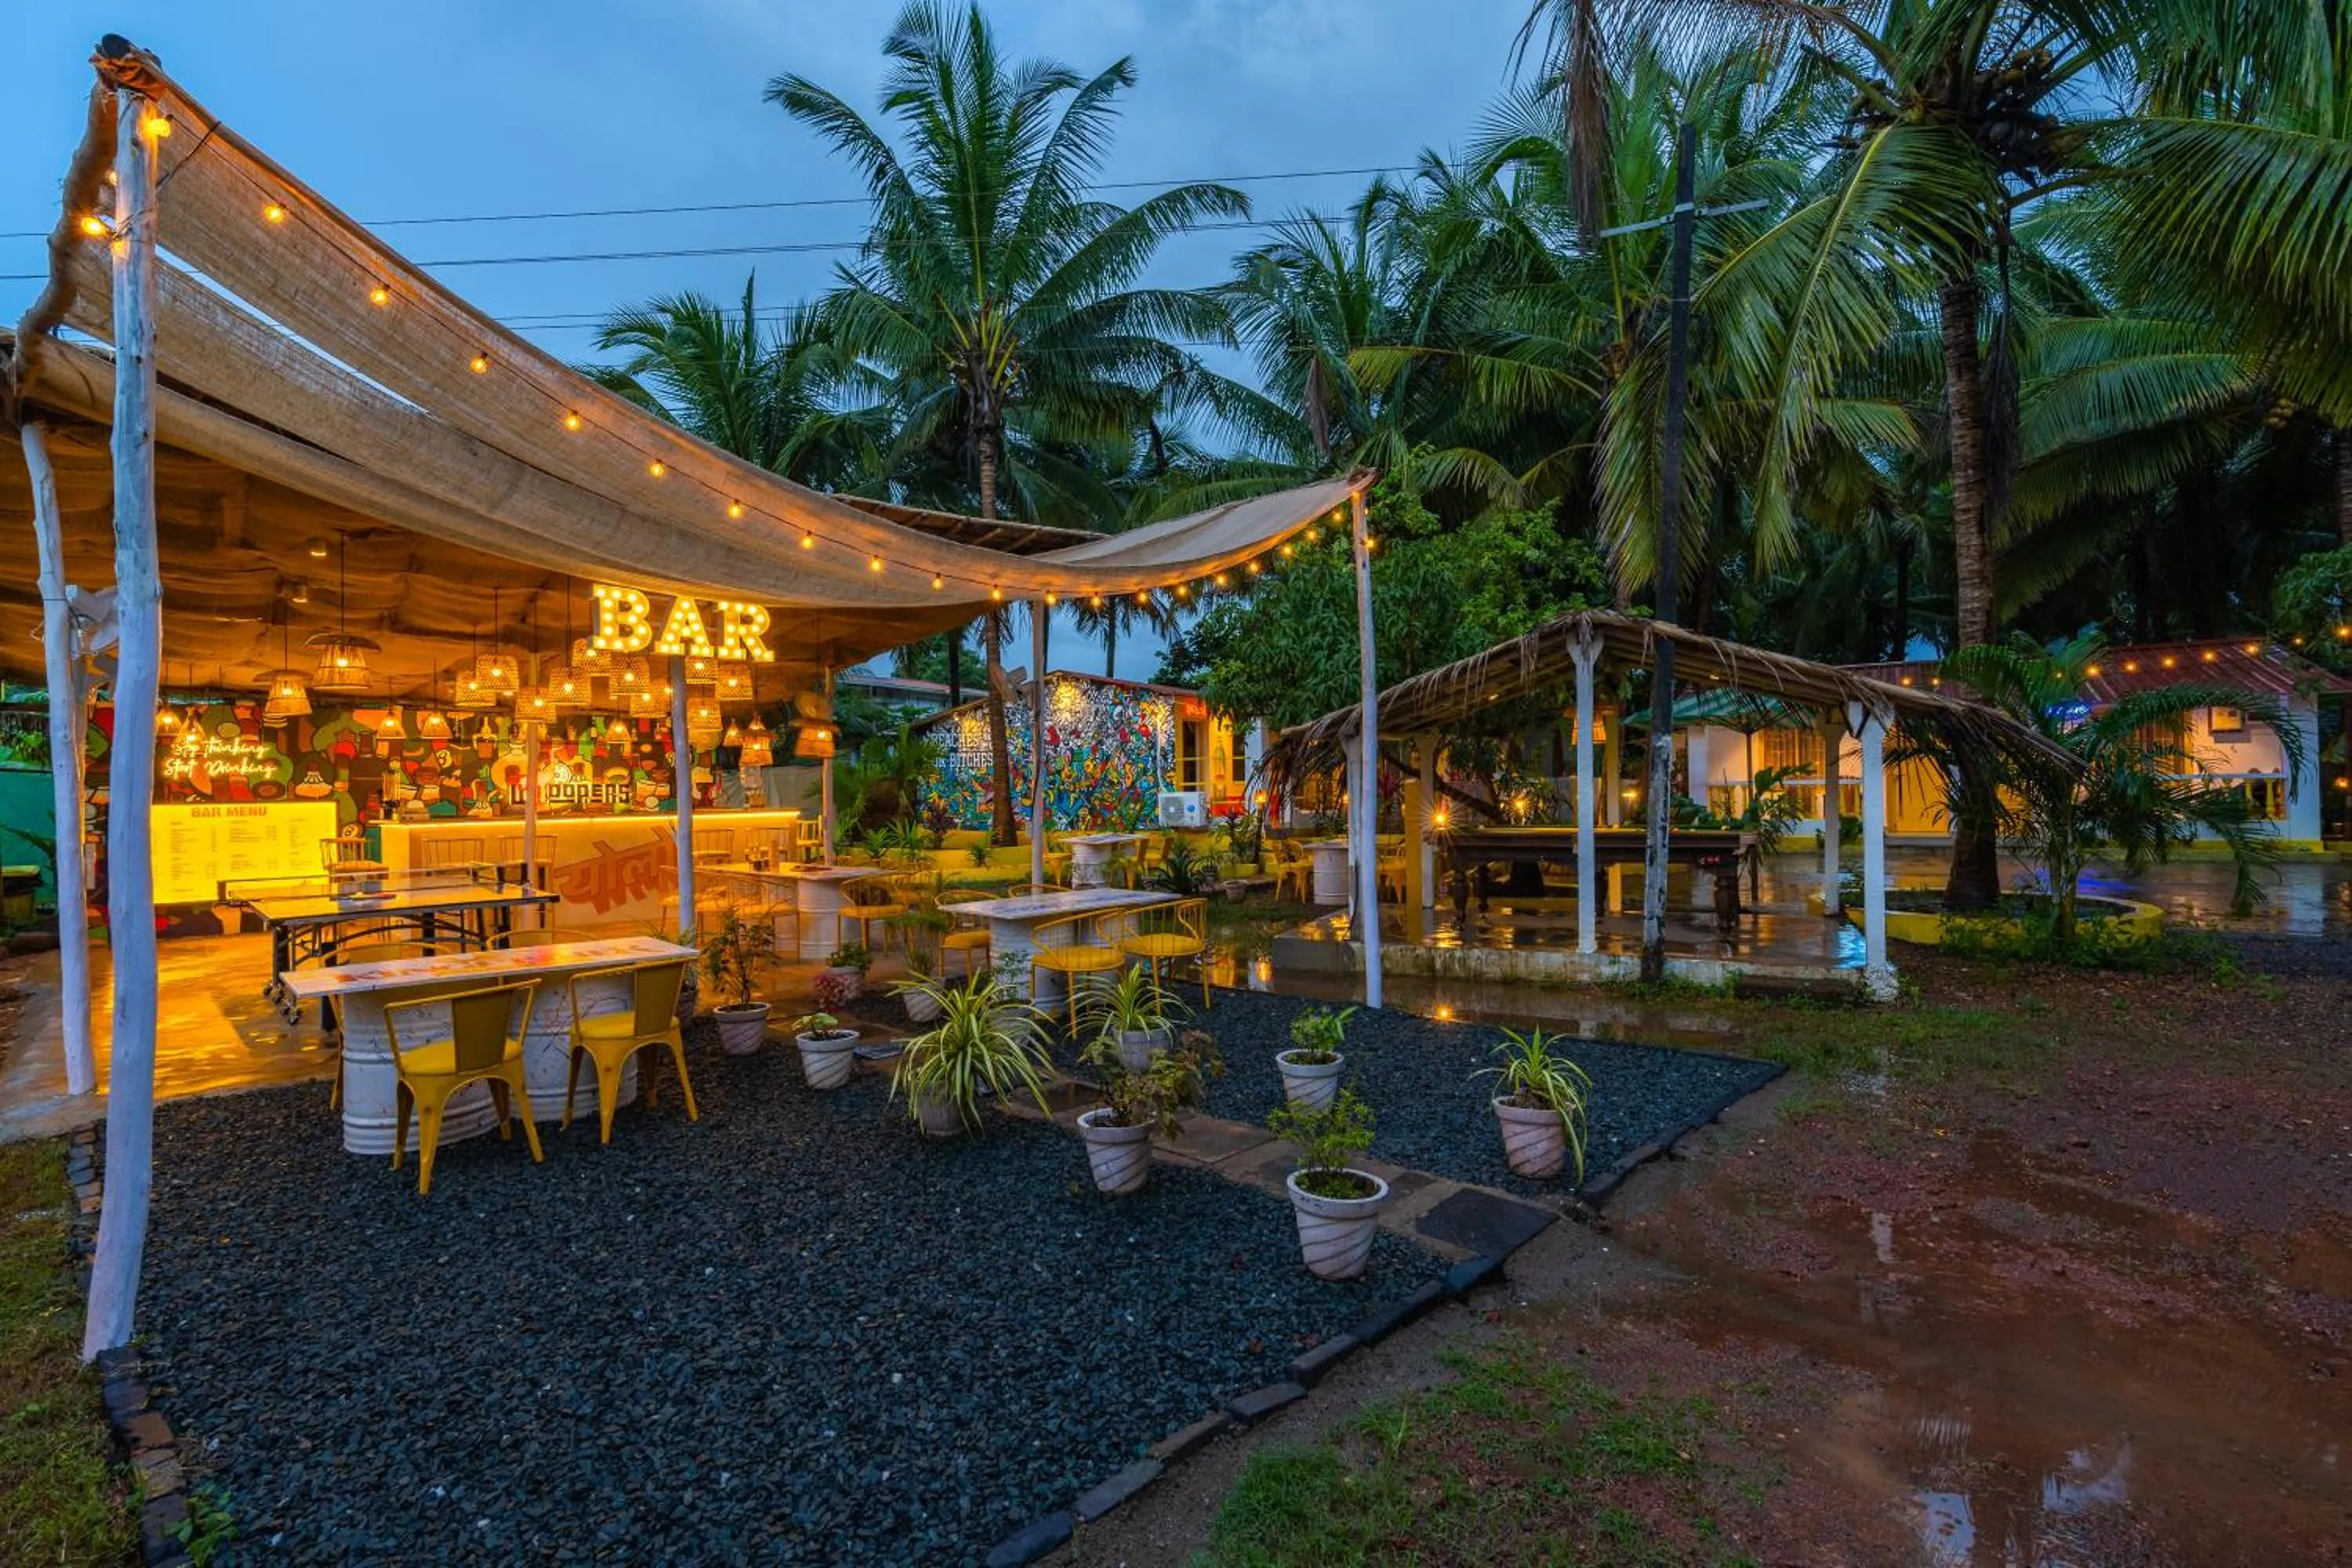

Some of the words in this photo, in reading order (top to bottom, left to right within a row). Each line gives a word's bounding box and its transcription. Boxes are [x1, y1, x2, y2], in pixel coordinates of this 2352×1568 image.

[592, 583, 775, 662] BAR
[204, 757, 278, 779] Drinking
[949, 752, 993, 768] BITCHES
[191, 807, 222, 818] BAR
[227, 805, 267, 817] MENU
